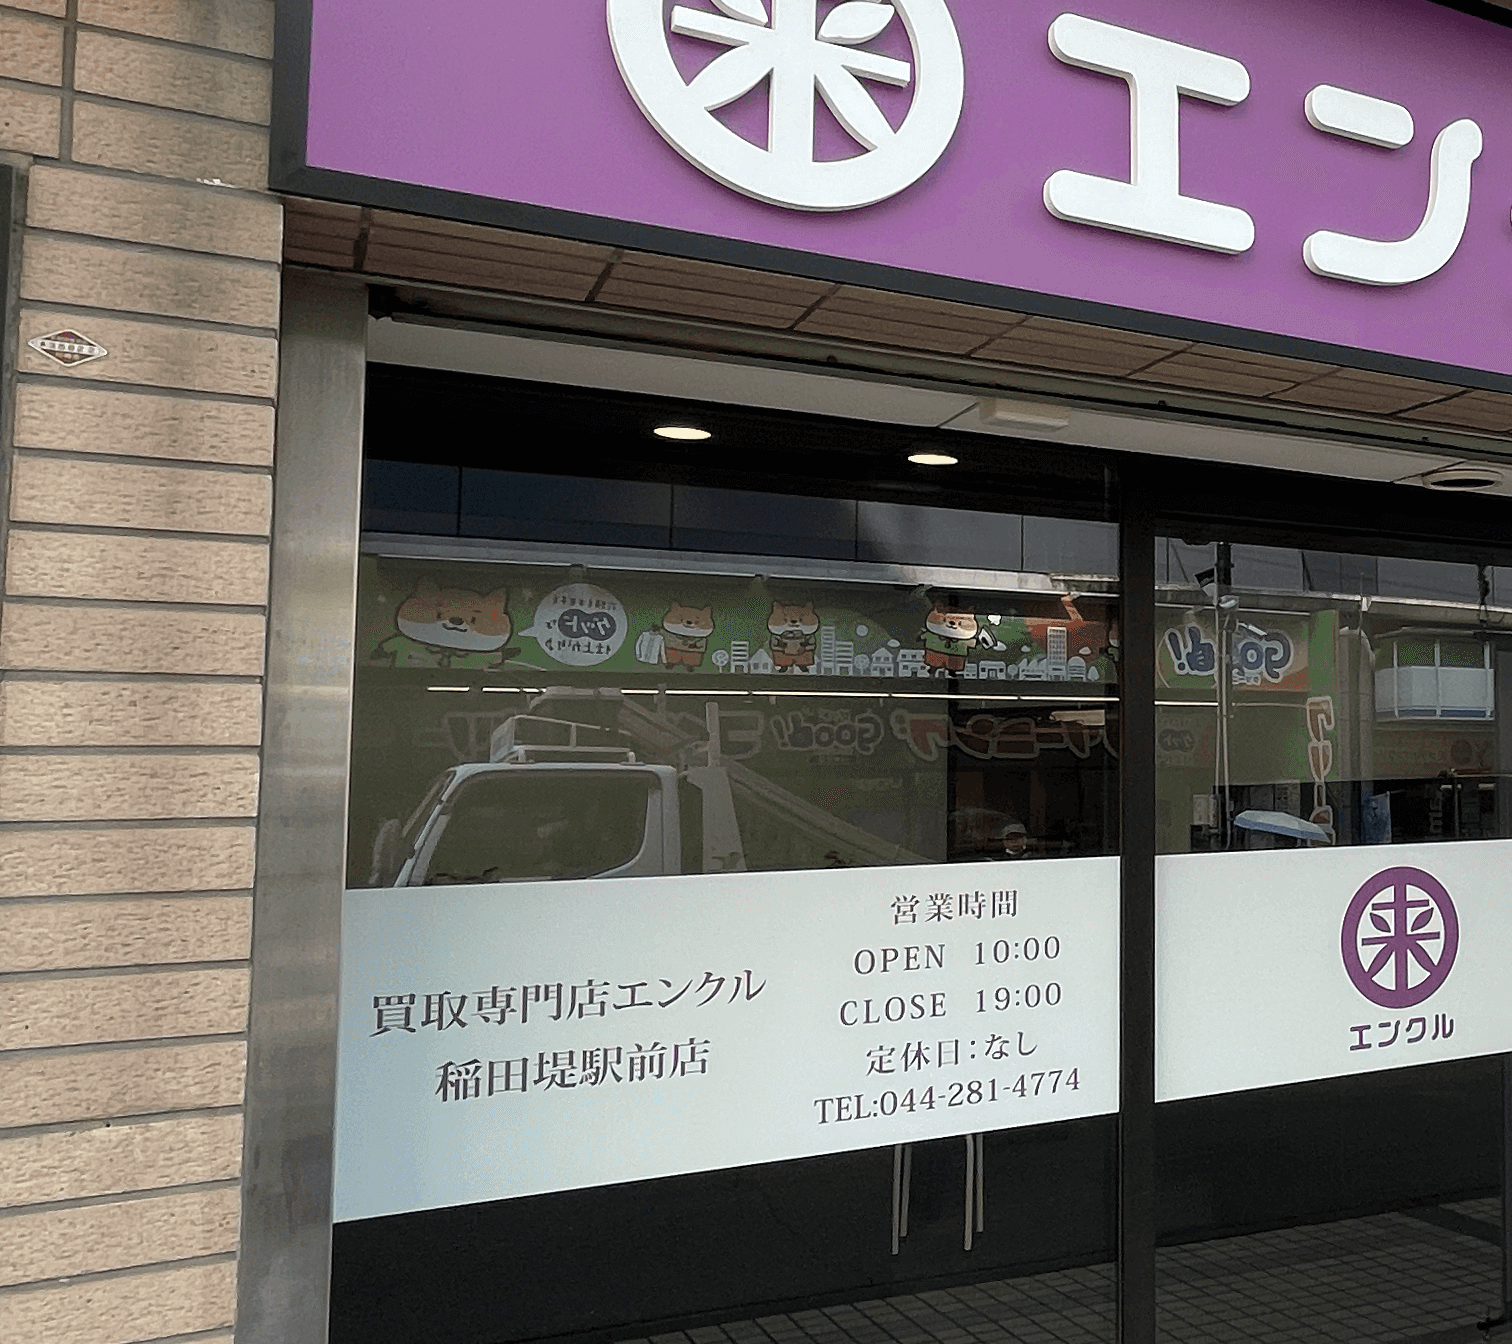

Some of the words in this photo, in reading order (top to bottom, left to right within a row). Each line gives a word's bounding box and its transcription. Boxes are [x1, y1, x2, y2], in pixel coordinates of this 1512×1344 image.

[891, 889, 1018, 925] 営業時間
[854, 944, 946, 975] OPEN
[974, 936, 1061, 967] 10:00
[370, 970, 766, 1038] 買取専門店エンクル
[840, 992, 947, 1027] CLOSE
[975, 983, 1062, 1013] 19:00
[1350, 1013, 1454, 1051] エンクル
[435, 1037, 710, 1102] 稲田堤駅前店
[866, 1032, 1037, 1077] 定休日：なし
[814, 1067, 1081, 1125] TEL:044-281-4774
